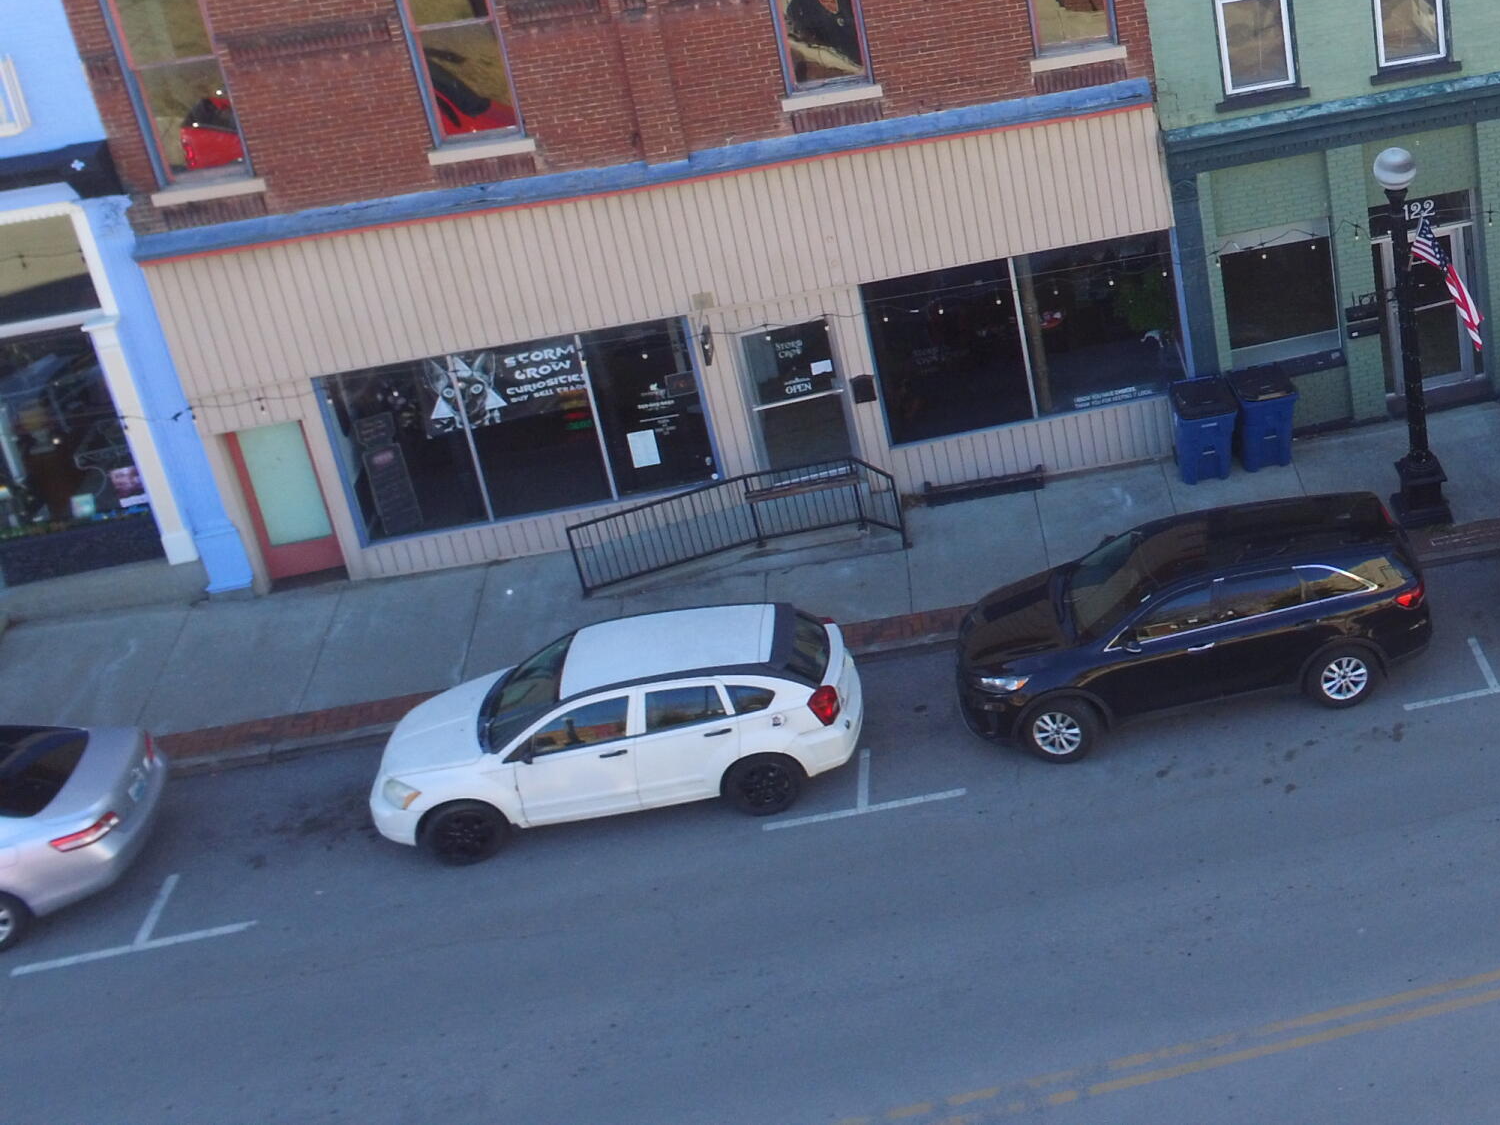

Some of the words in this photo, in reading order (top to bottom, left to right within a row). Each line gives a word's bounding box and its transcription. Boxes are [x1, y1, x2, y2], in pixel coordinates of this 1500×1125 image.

[1402, 199, 1436, 221] 122
[503, 344, 575, 368] STORM
[514, 360, 571, 380] CROW
[785, 383, 812, 394] OPEN
